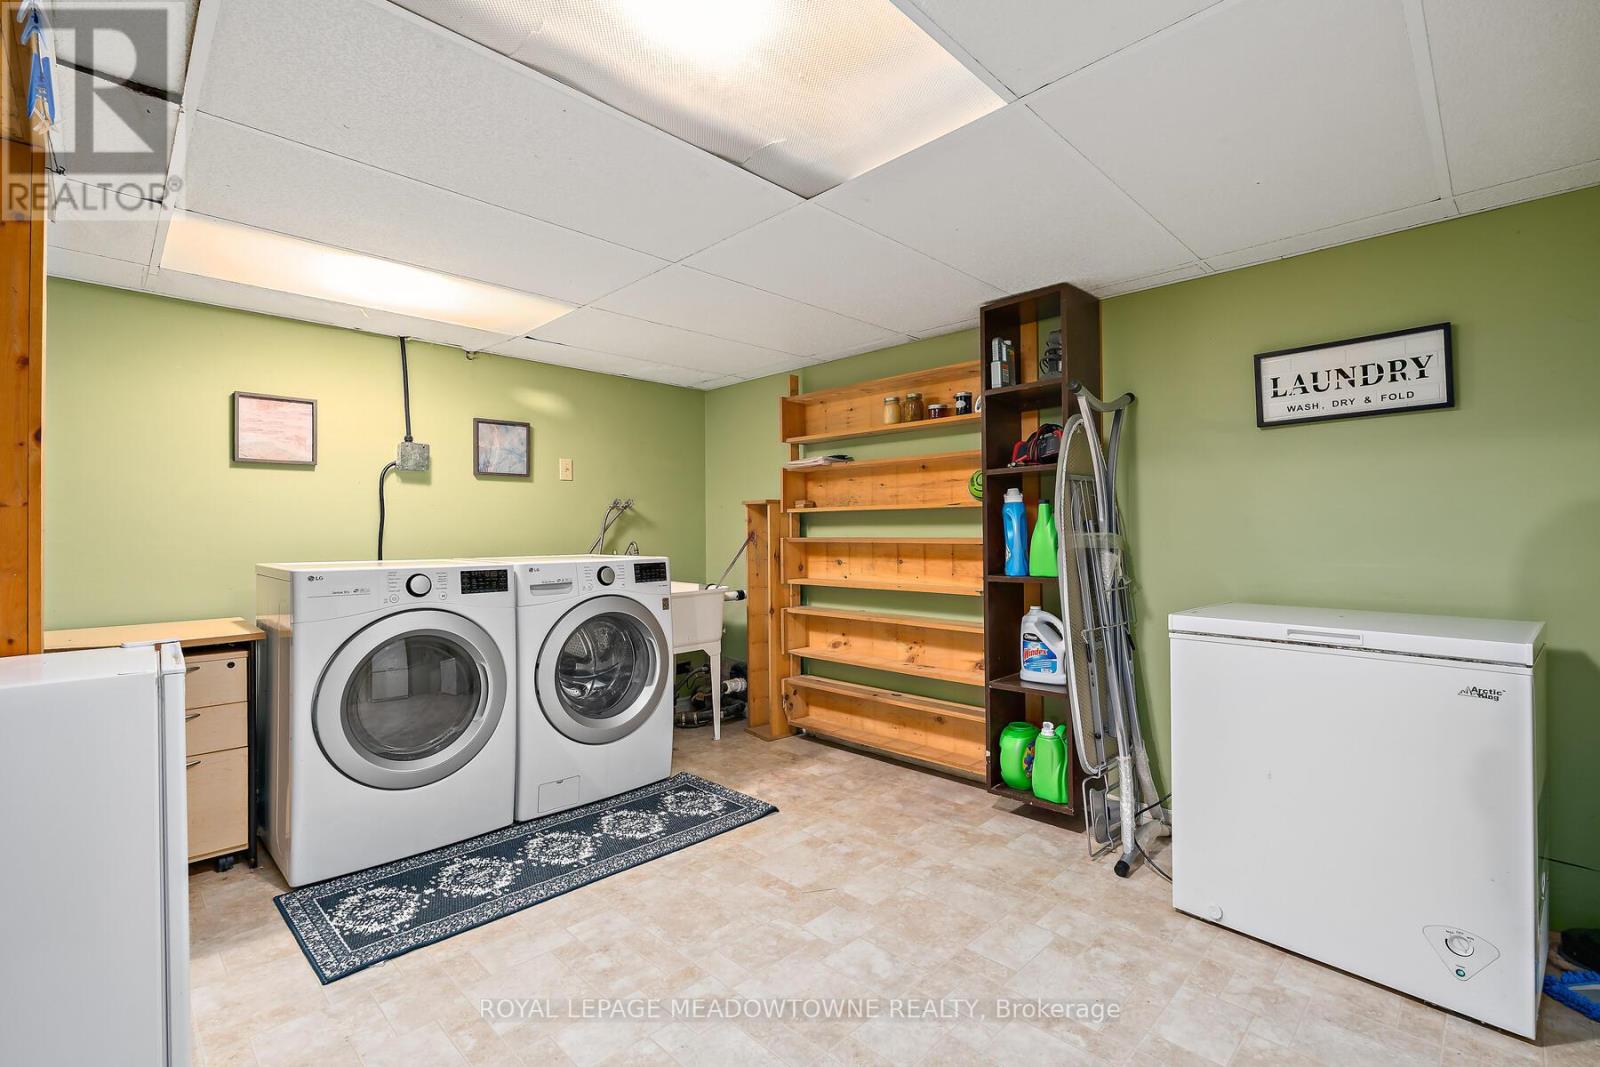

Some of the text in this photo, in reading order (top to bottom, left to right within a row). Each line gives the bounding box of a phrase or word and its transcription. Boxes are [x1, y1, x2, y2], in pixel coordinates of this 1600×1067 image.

[1270, 354, 1433, 398] LAUNDRY
[1332, 398, 1355, 408] DRY
[1364, 396, 1372, 404] &
[1381, 391, 1415, 402] FOLD
